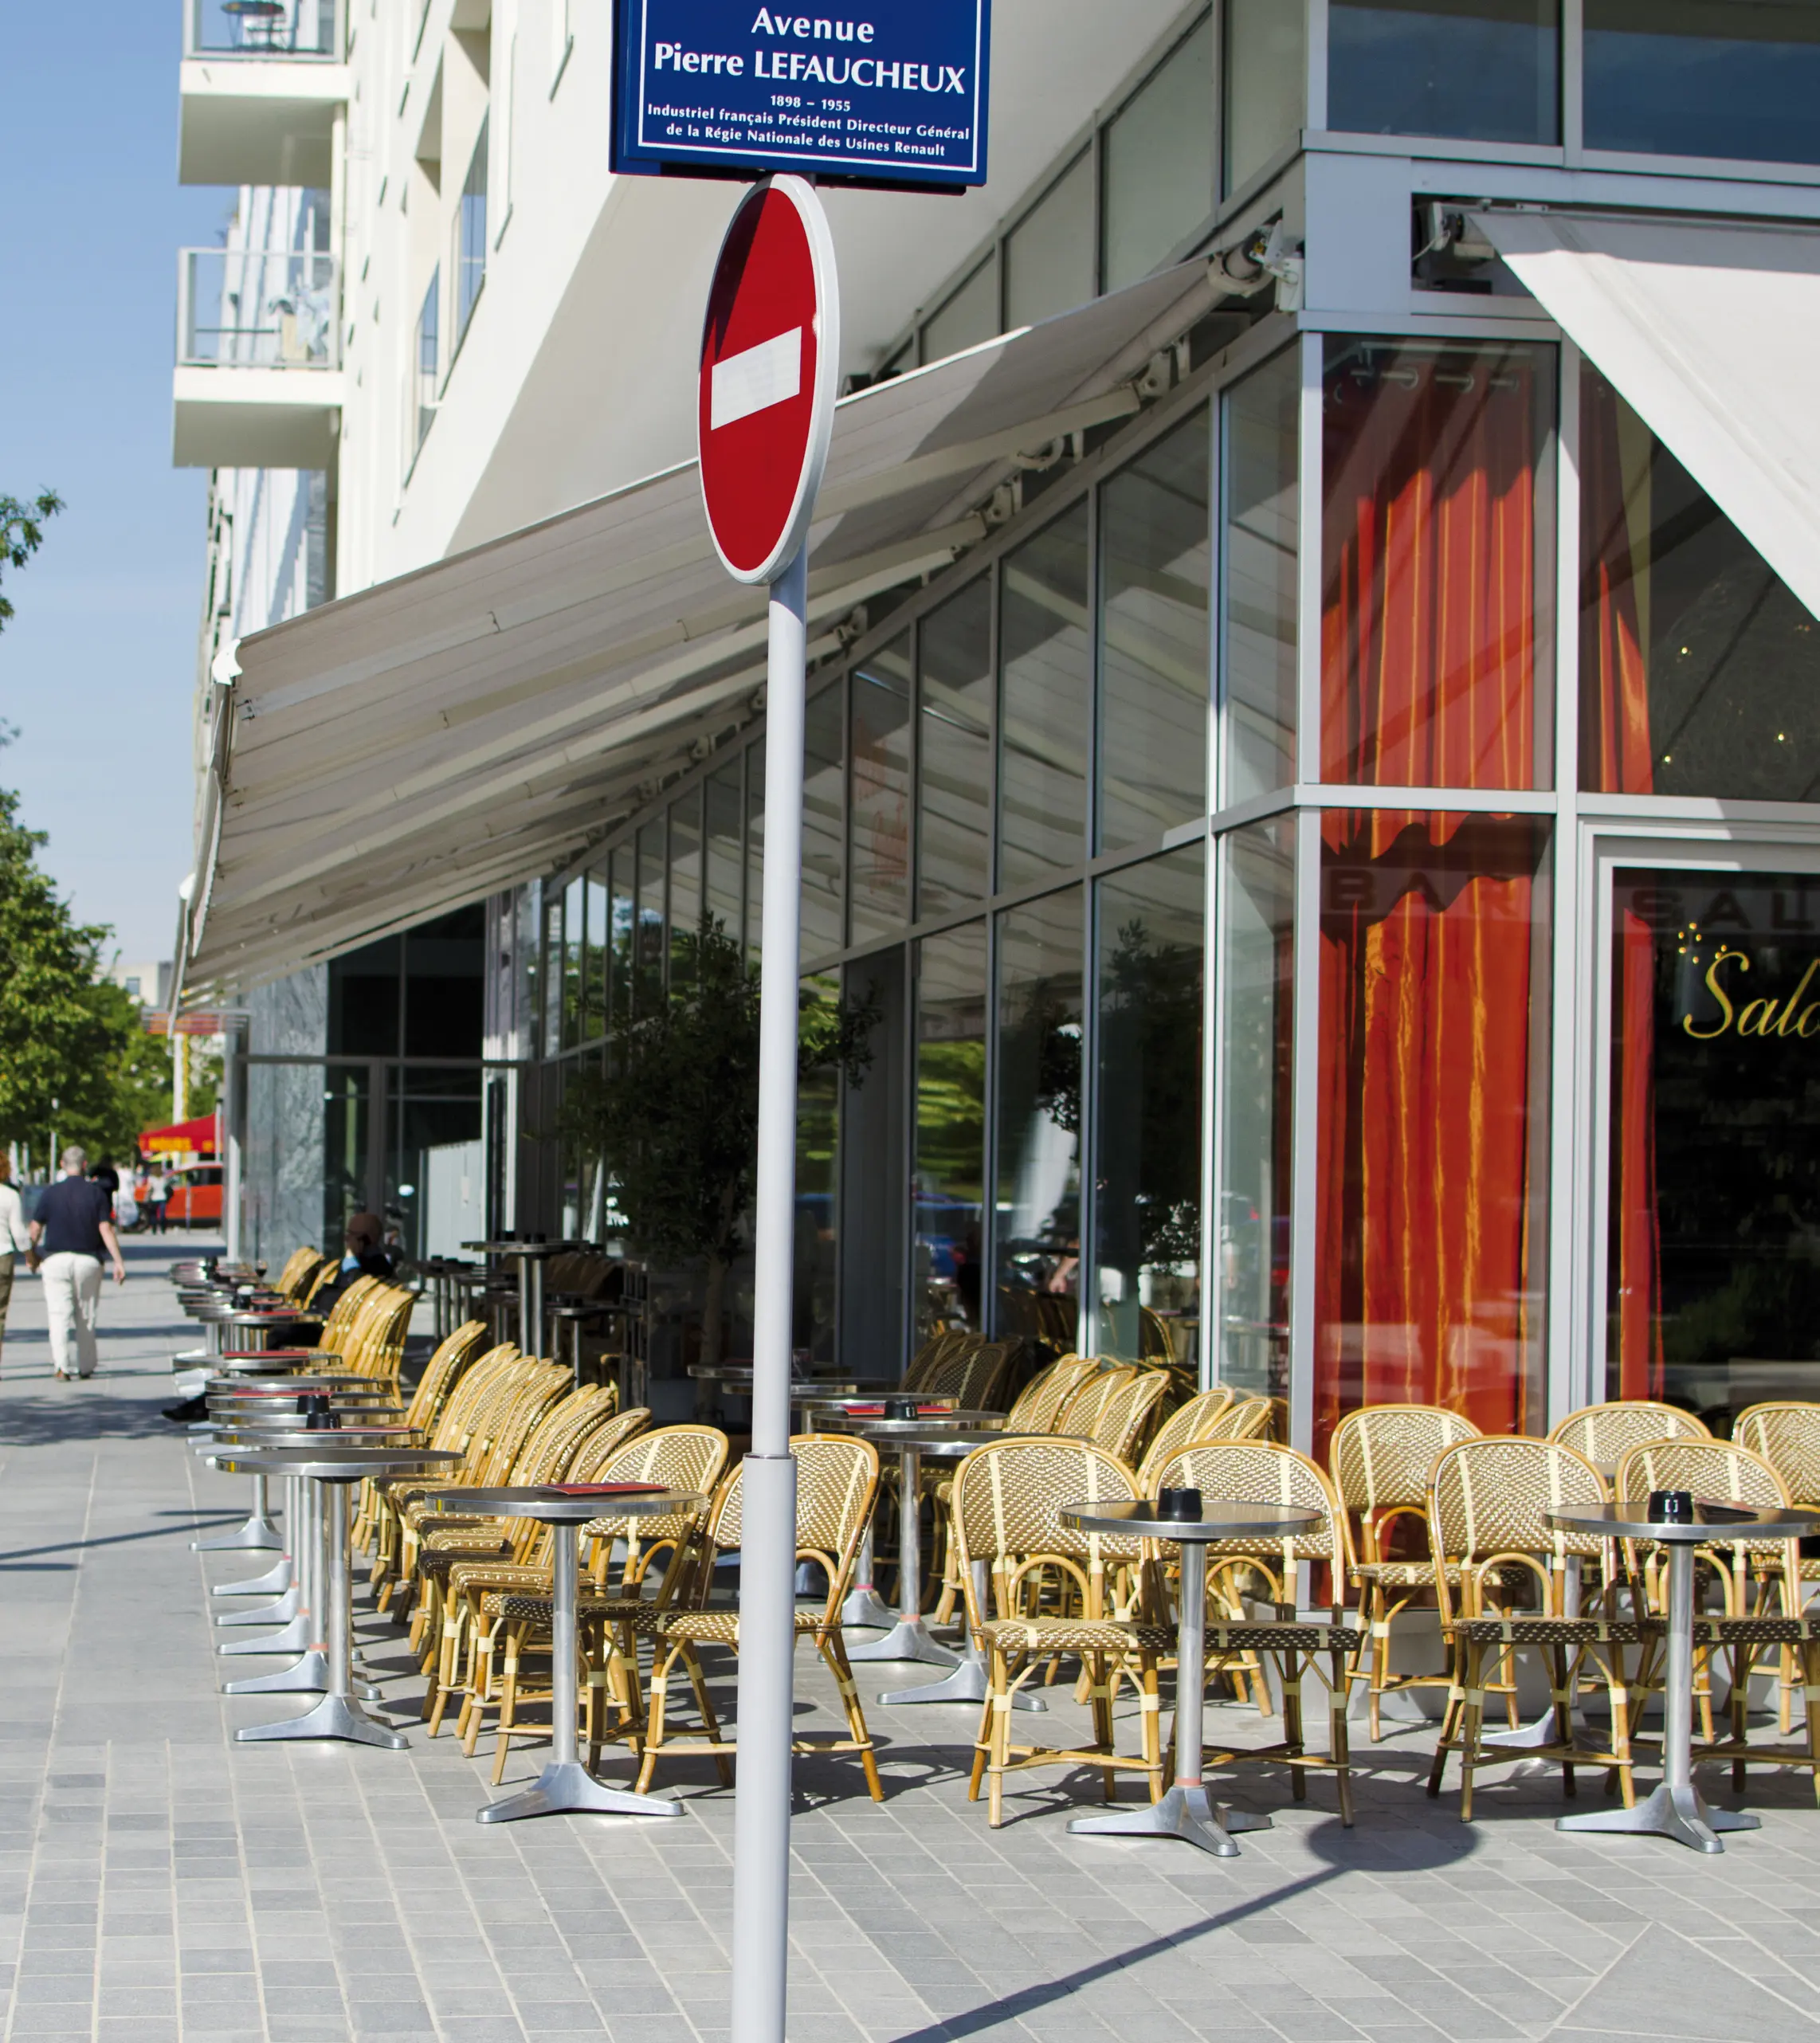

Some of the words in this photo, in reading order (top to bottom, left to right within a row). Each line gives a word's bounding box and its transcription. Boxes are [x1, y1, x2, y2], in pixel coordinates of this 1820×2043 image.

[751, 7, 874, 43] Avenue
[655, 43, 744, 76] Pierre
[755, 50, 966, 94] LEFAUCHEUX
[771, 95, 801, 108] 1898
[822, 99, 851, 112] 1955
[648, 104, 714, 120] Industriel
[720, 108, 773, 126] français
[779, 113, 841, 130] Président
[847, 120, 912, 135] Directeur
[916, 125, 970, 139] Général
[667, 123, 683, 135] de
[688, 124, 700, 137] la
[705, 126, 742, 142] Régie
[747, 130, 813, 146] Nationale
[818, 134, 841, 147] des
[846, 137, 890, 152] Usines
[895, 142, 945, 156] Renault
[1329, 869, 1517, 916] BAR
